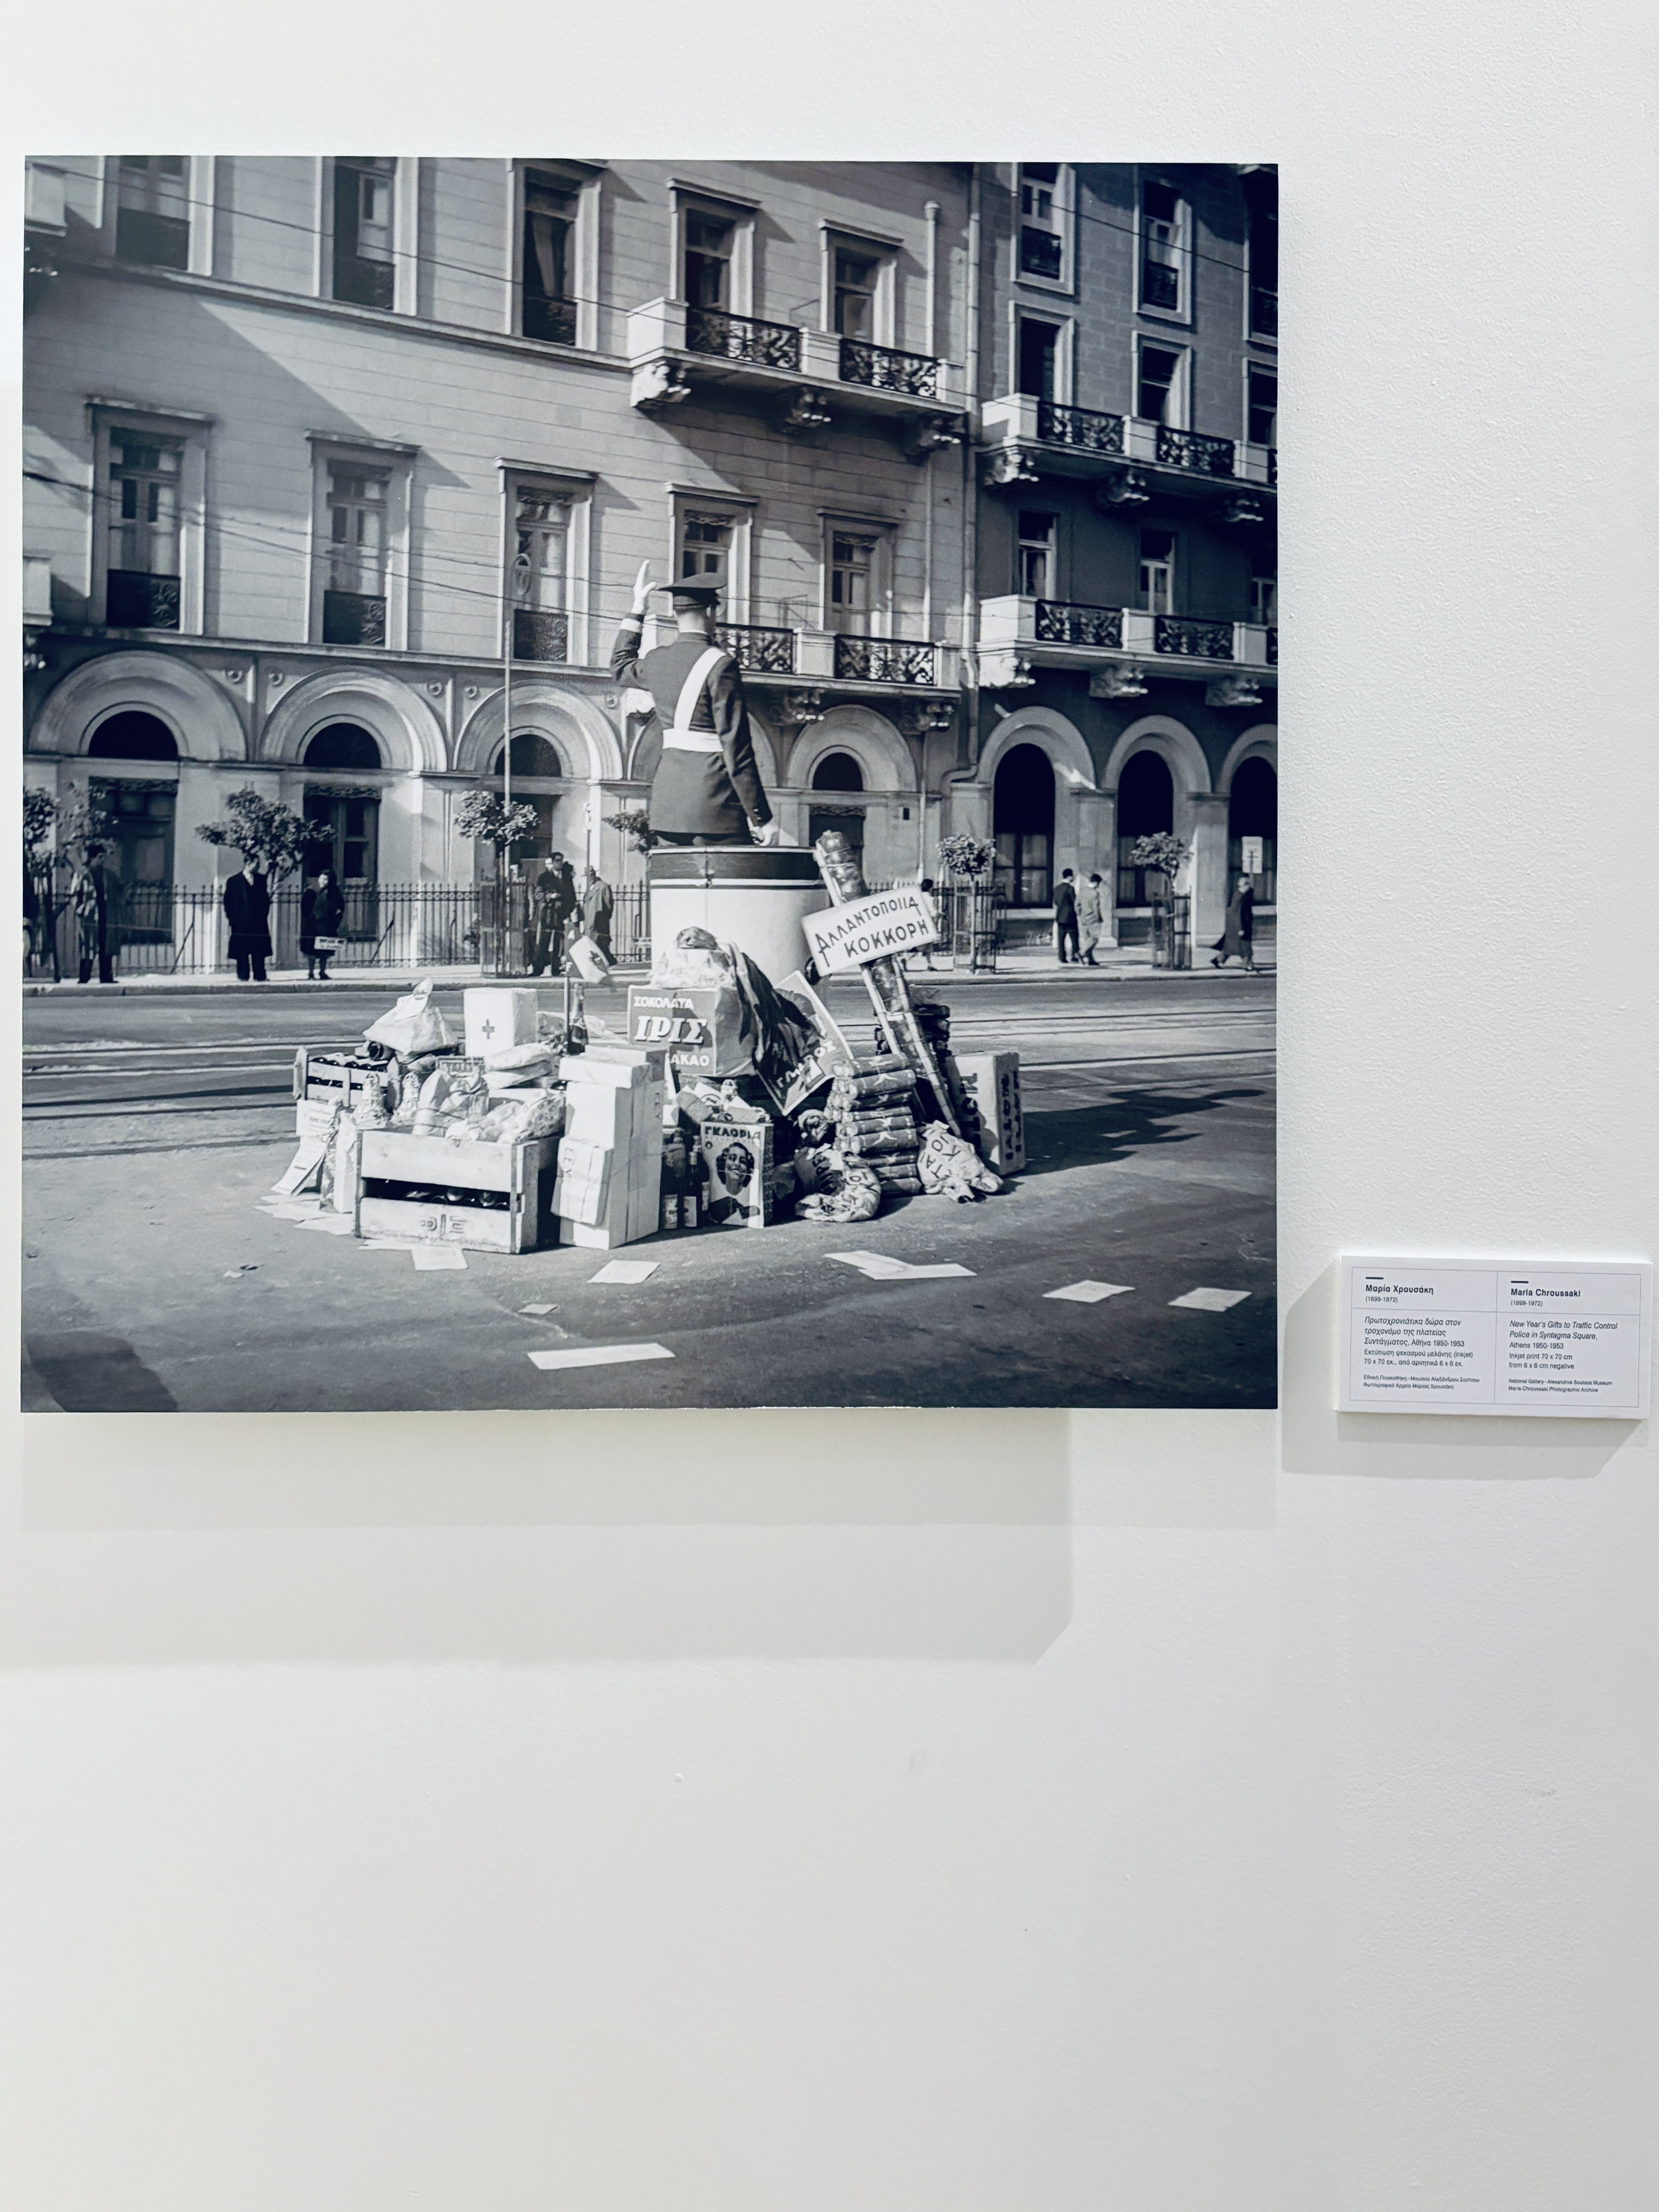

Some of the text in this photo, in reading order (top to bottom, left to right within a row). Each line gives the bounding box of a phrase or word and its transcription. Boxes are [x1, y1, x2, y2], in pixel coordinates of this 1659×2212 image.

[844, 920, 929, 958] ΚΟΚΚΟΡΗ
[634, 996, 694, 1009] ΣΟΚΟΛΑΤΑ
[634, 1016, 707, 1044] ΙΡΙΣ
[669, 1052, 710, 1066] ΑΚΑΟ
[1365, 1285, 1433, 1295] Μαρία Χρουσάκη
[1536, 1289, 1581, 1297] Chroussaki
[1365, 1316, 1423, 1325] Πρωτοχρονιάτικα
[1425, 1318, 1443, 1326] δώρα
[1364, 1328, 1401, 1336] τροχονόμο
[1539, 1332, 1571, 1340] Syntagma
[1364, 1337, 1410, 1346] Συντάγματος,
